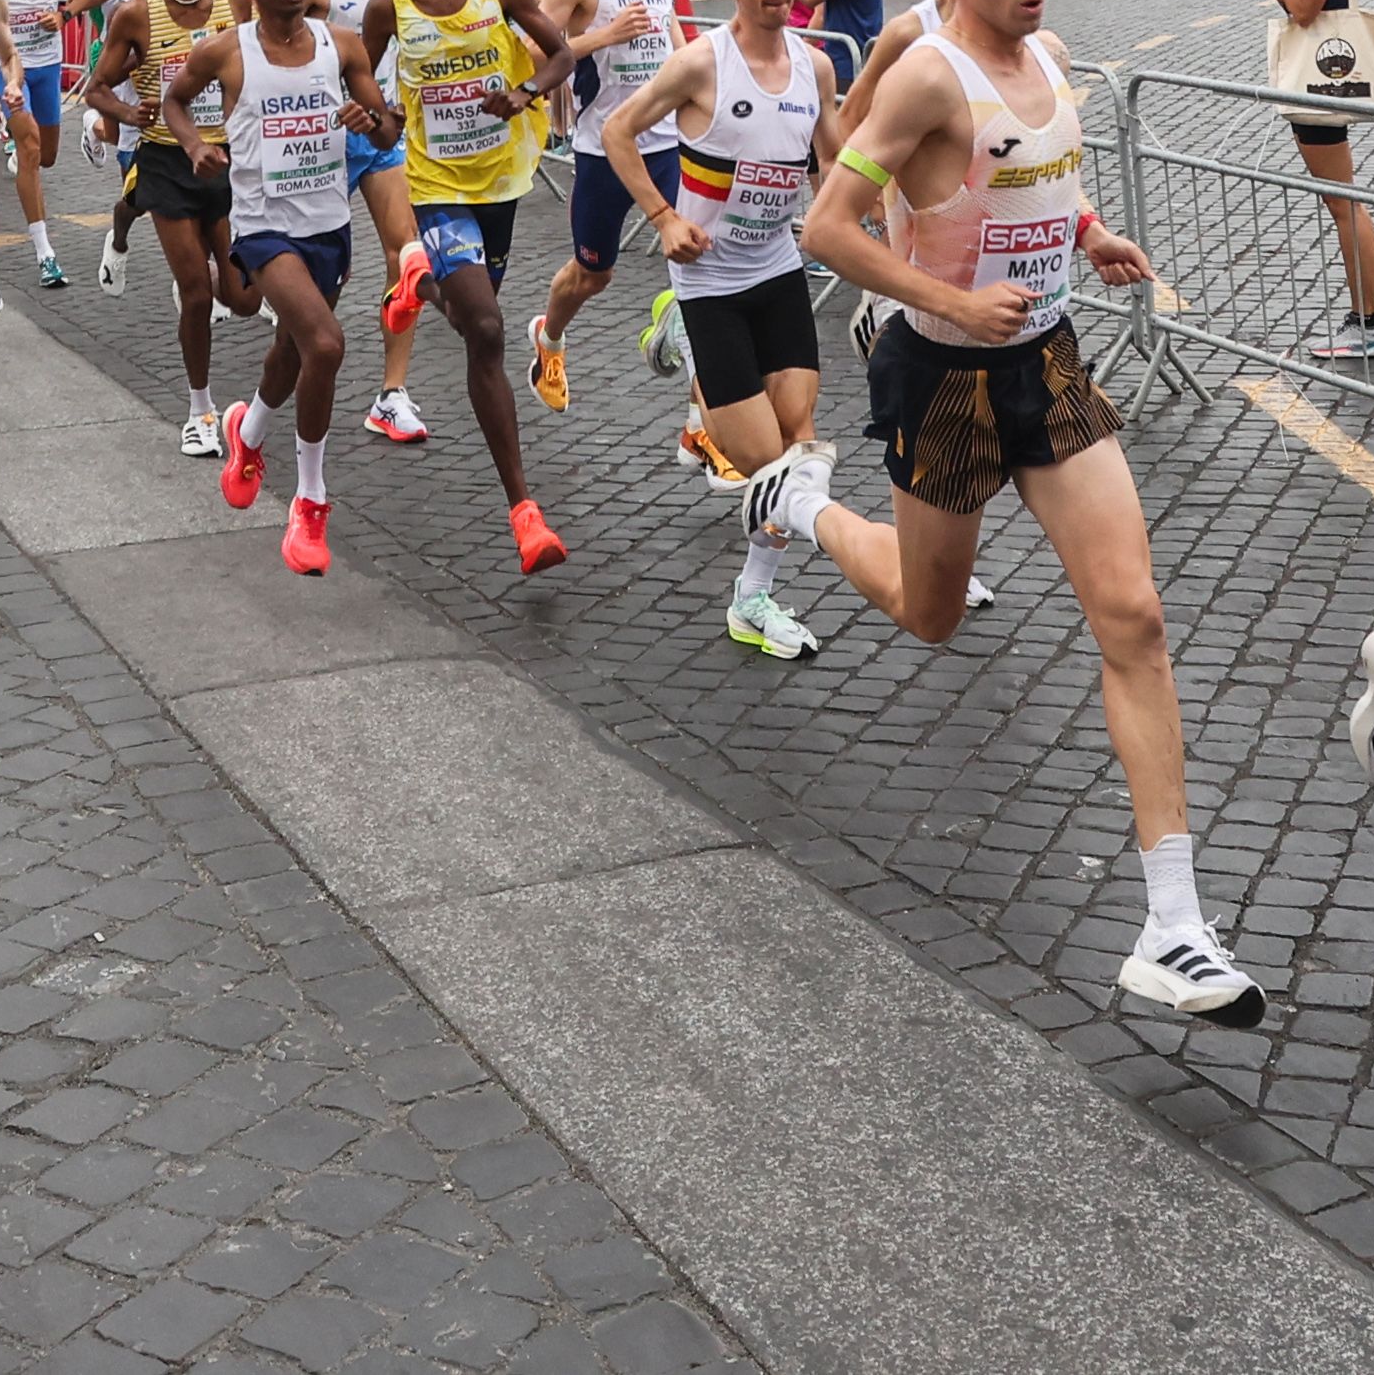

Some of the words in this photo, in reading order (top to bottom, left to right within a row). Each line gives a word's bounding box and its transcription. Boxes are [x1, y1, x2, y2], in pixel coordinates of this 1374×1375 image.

[629, 37, 667, 51] MOEN
[420, 46, 500, 80] SWEDEN
[640, 51, 655, 60] 311
[620, 73, 651, 83] ROMA
[422, 82, 482, 103] SPAR
[262, 91, 329, 116] ISRAEL
[433, 103, 484, 121] HASSA
[777, 101, 807, 115] Allianz
[263, 116, 328, 137] SPAR
[457, 119, 476, 131] 332
[282, 137, 330, 157] AYALE
[439, 142, 474, 155] ROMA
[476, 134, 501, 150] 2024
[298, 155, 318, 167] 280
[276, 180, 311, 193] ROMA
[314, 175, 337, 189] 2024
[738, 164, 802, 187] SPAR
[760, 208, 780, 219] 205
[730, 227, 766, 242] ROMA
[985, 220, 1066, 250] SPAR
[1007, 253, 1063, 279] MAYO
[1039, 304, 1062, 328] 2024
